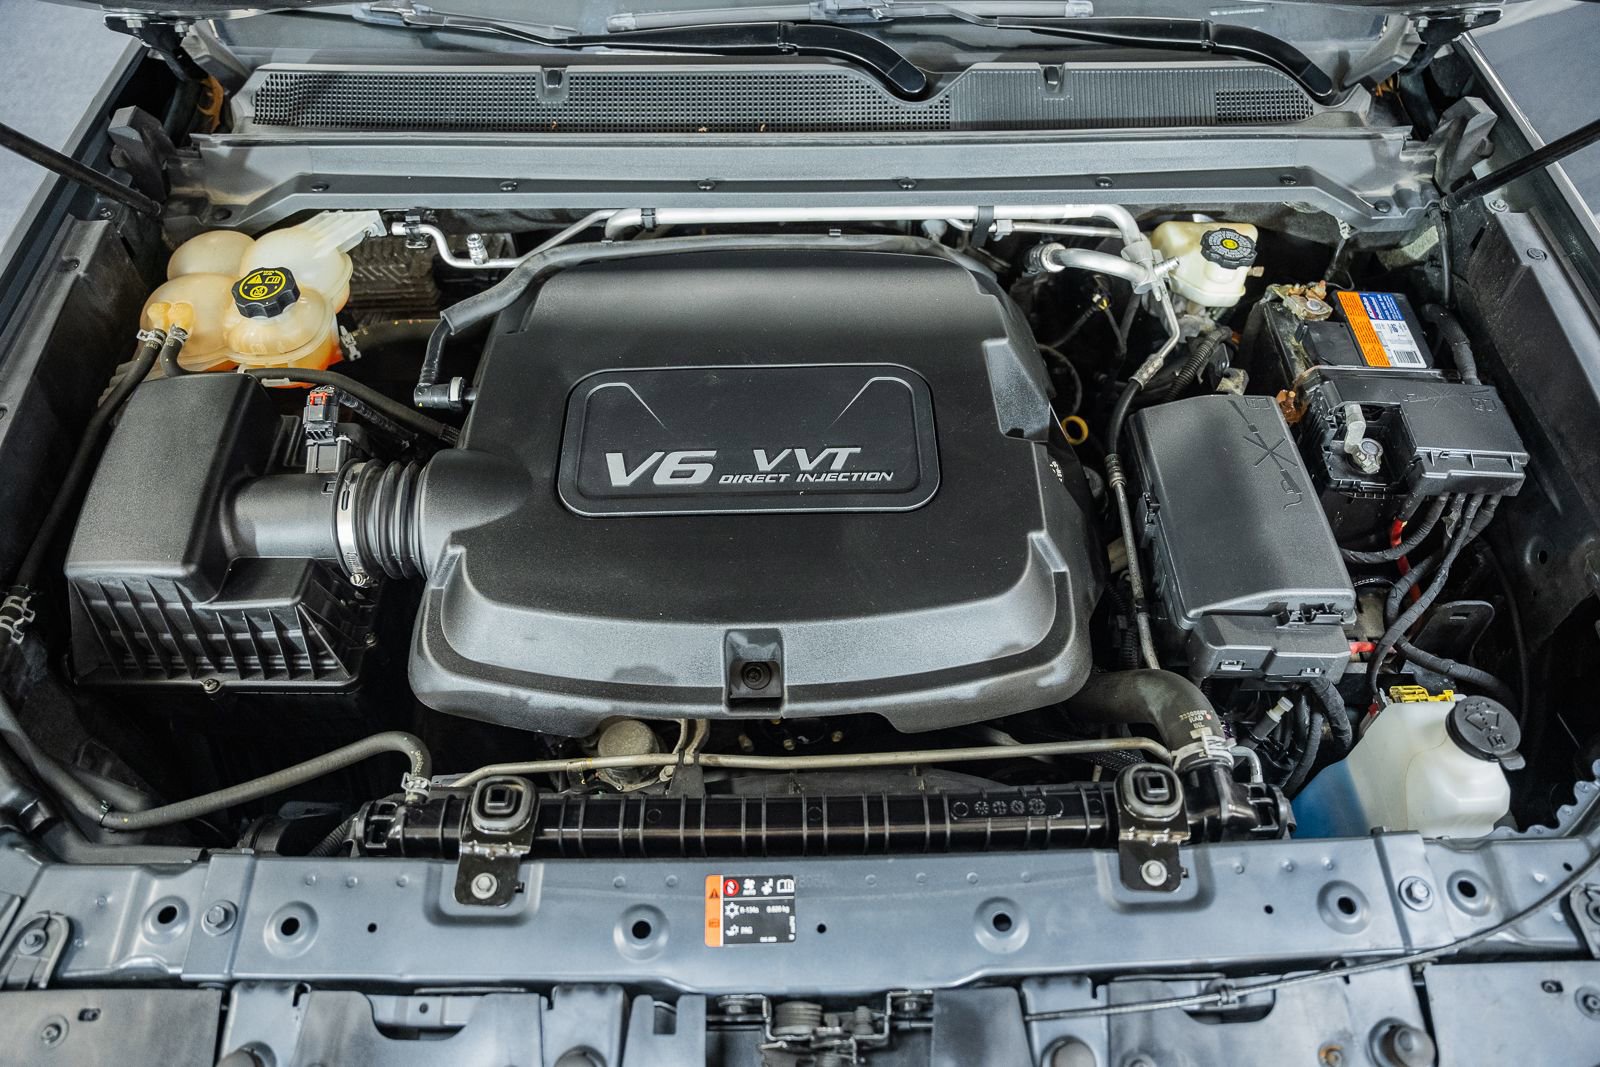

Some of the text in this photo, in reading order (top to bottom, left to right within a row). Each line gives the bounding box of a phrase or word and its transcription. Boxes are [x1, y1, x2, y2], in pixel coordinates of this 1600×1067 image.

[605, 447, 862, 487] V6 VVT
[718, 471, 894, 485] DIRECT INJECTION
